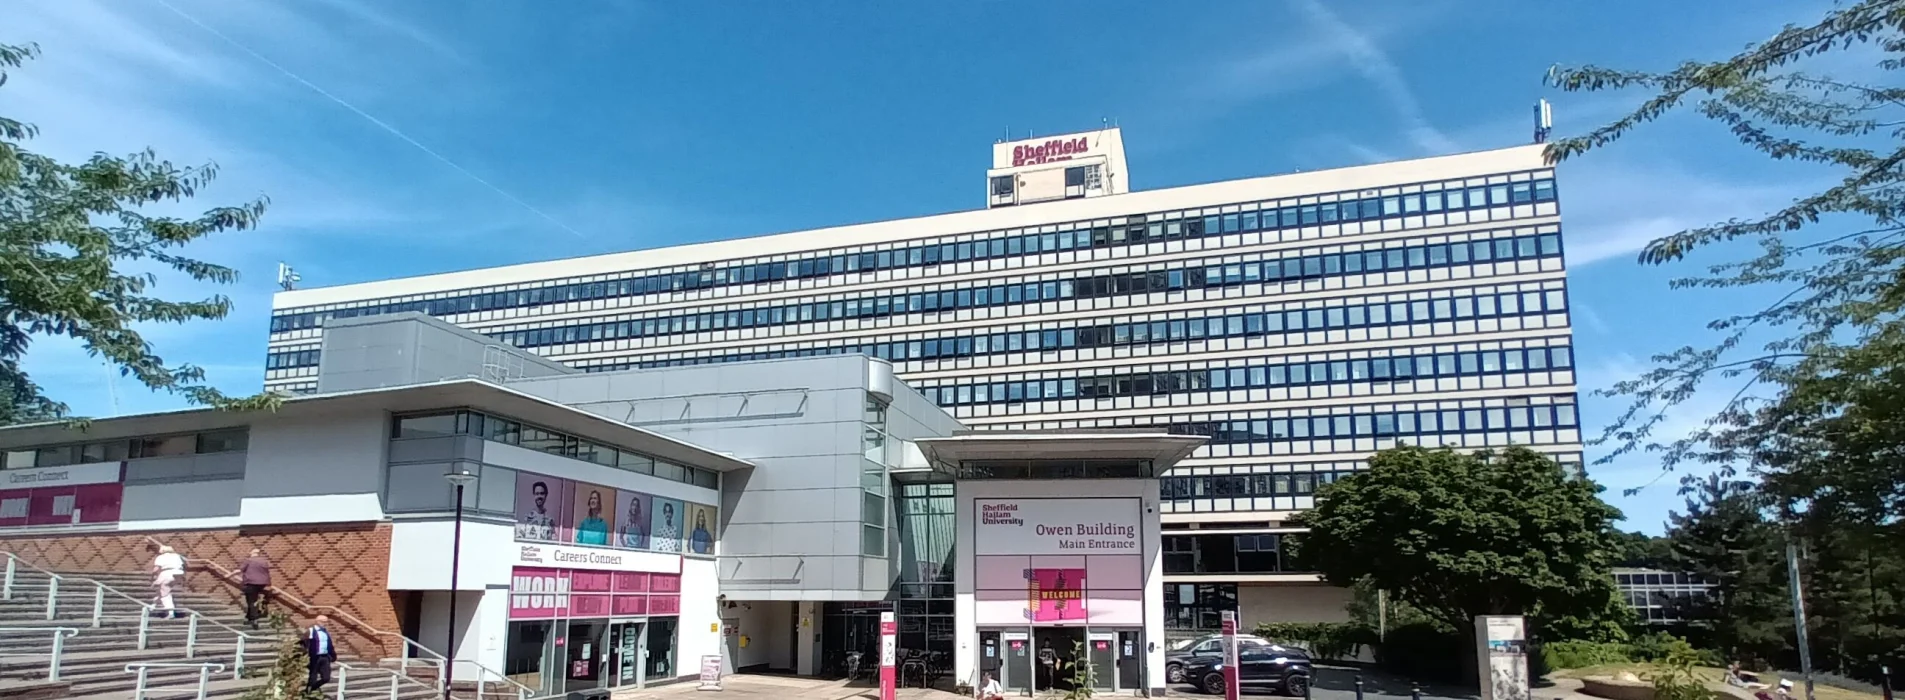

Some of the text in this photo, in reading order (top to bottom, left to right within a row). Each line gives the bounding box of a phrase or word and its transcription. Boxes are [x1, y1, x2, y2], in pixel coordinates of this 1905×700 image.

[1013, 137, 1088, 160] Sheffield
[982, 518, 1024, 526] University
[1036, 523, 1135, 538] Owen Building
[1059, 539, 1135, 549] Main Entrance
[554, 550, 622, 564] Careers Connect
[512, 575, 569, 609] WORK
[1042, 590, 1080, 599] WELCOME
[622, 628, 636, 680] COME IN
